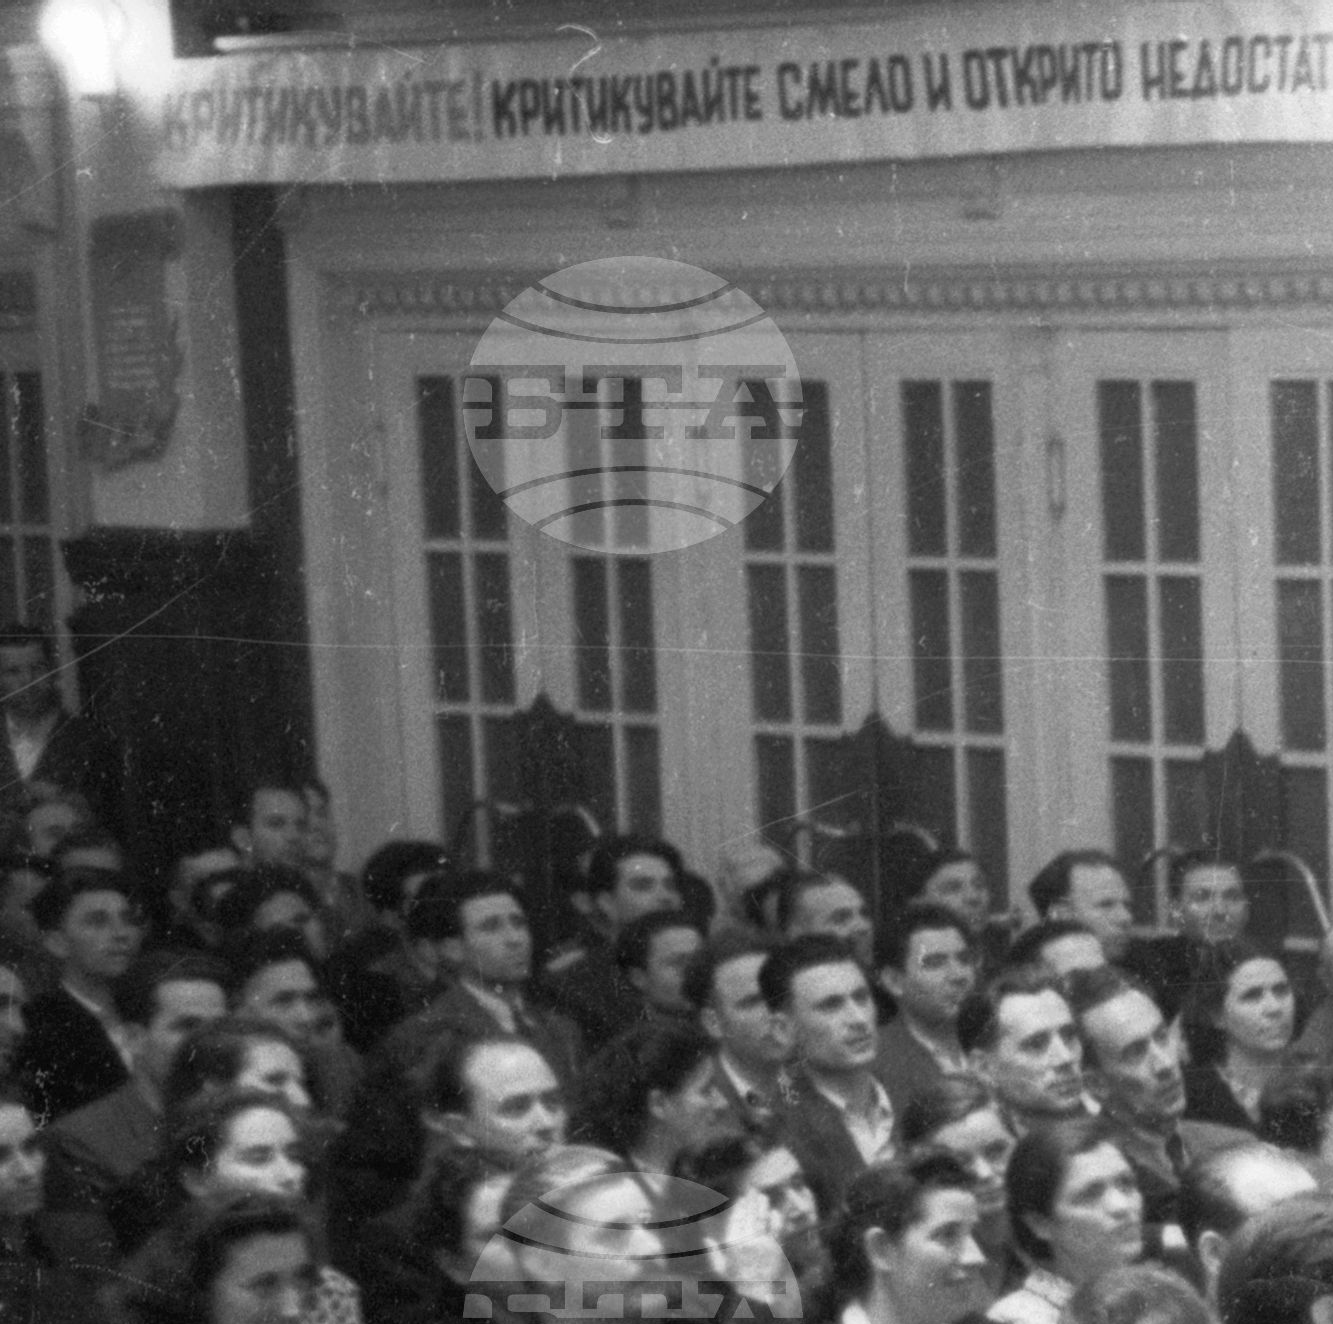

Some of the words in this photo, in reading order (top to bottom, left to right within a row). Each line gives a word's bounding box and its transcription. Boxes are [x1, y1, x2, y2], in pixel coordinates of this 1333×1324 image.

[492, 56, 763, 138] КРИТИКУВАЙТЕ
[776, 55, 913, 120] СМЕЛО
[922, 53, 951, 113] И
[962, 40, 1123, 111] ОТКРИТО
